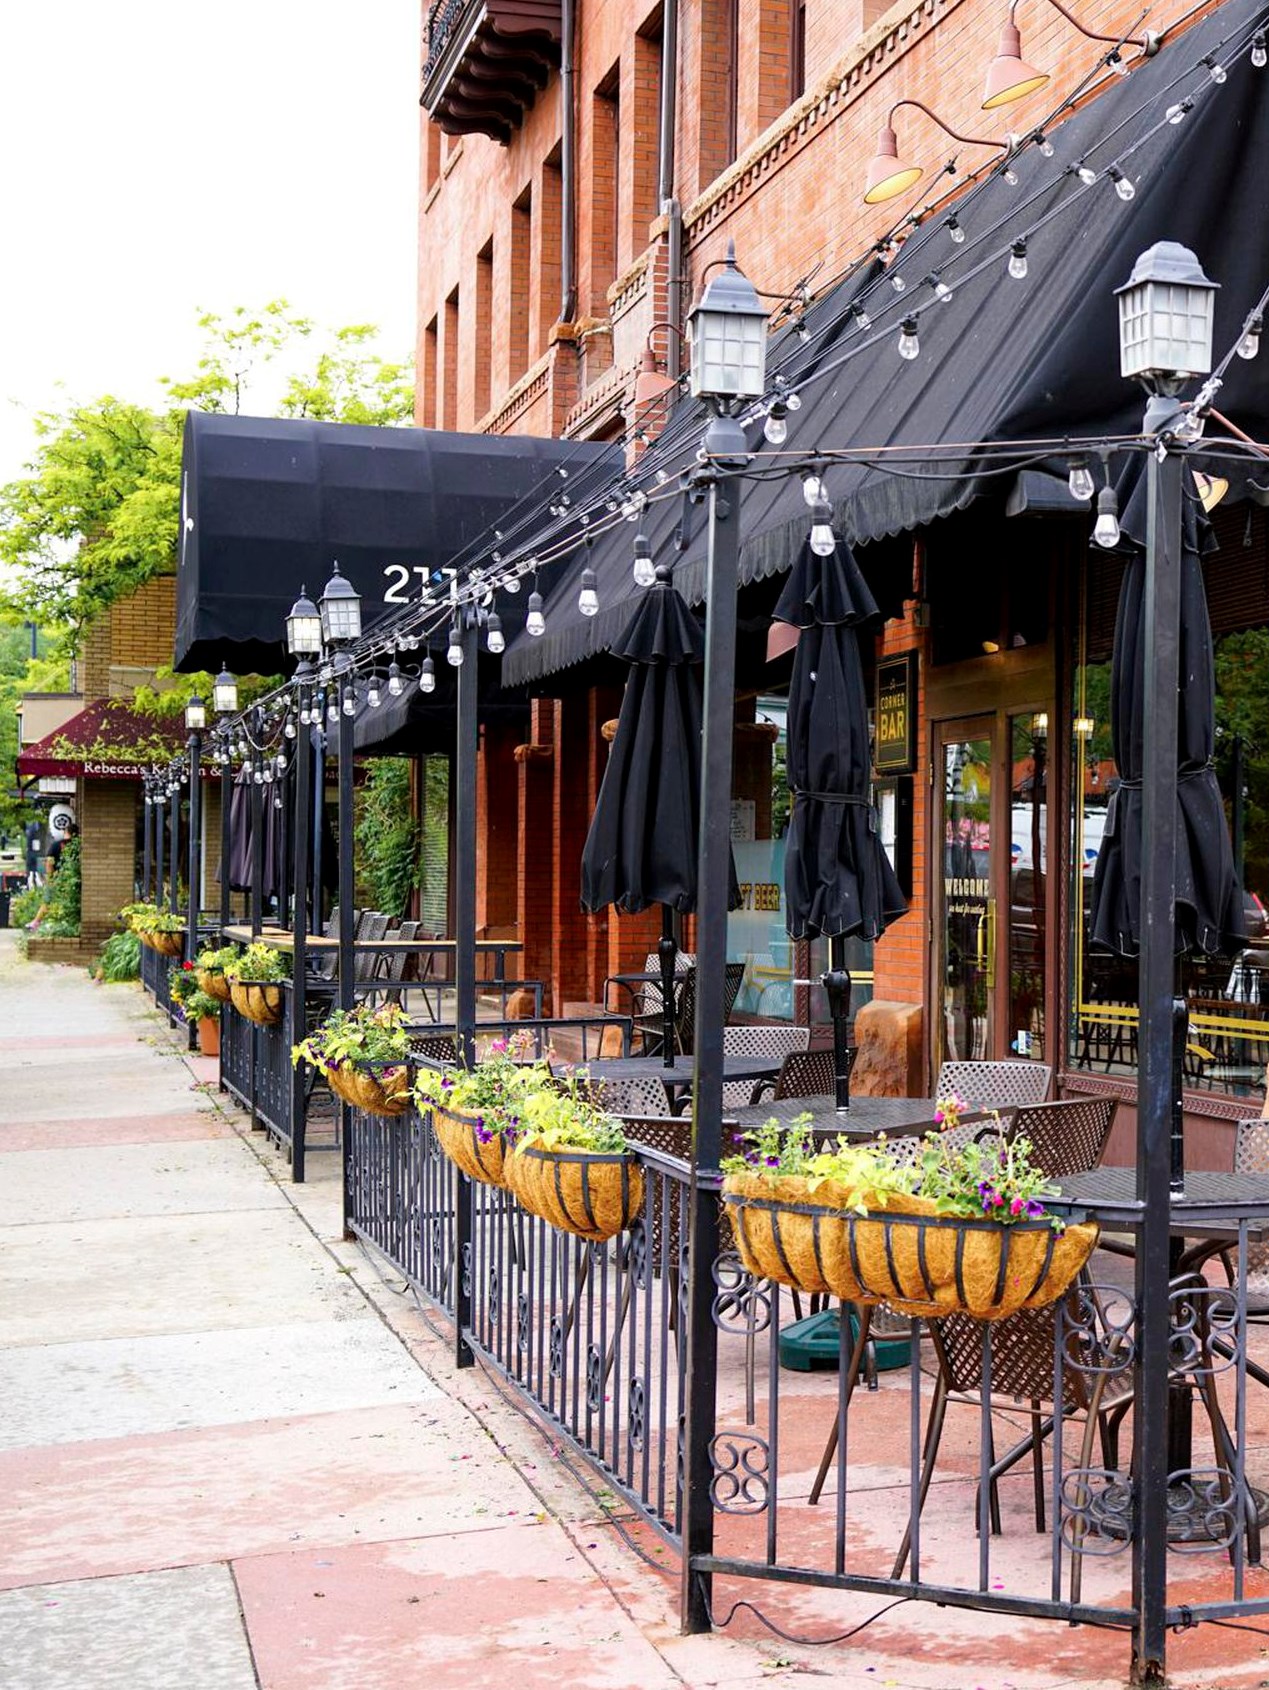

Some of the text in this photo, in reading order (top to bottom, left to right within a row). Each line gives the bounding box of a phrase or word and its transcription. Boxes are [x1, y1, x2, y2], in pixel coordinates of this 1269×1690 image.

[880, 692, 905, 711] CORNER
[880, 710, 905, 741] BAR
[84, 761, 145, 775] Rebecca's
[754, 883, 780, 911] BEER
[944, 878, 990, 897] WELCOME
